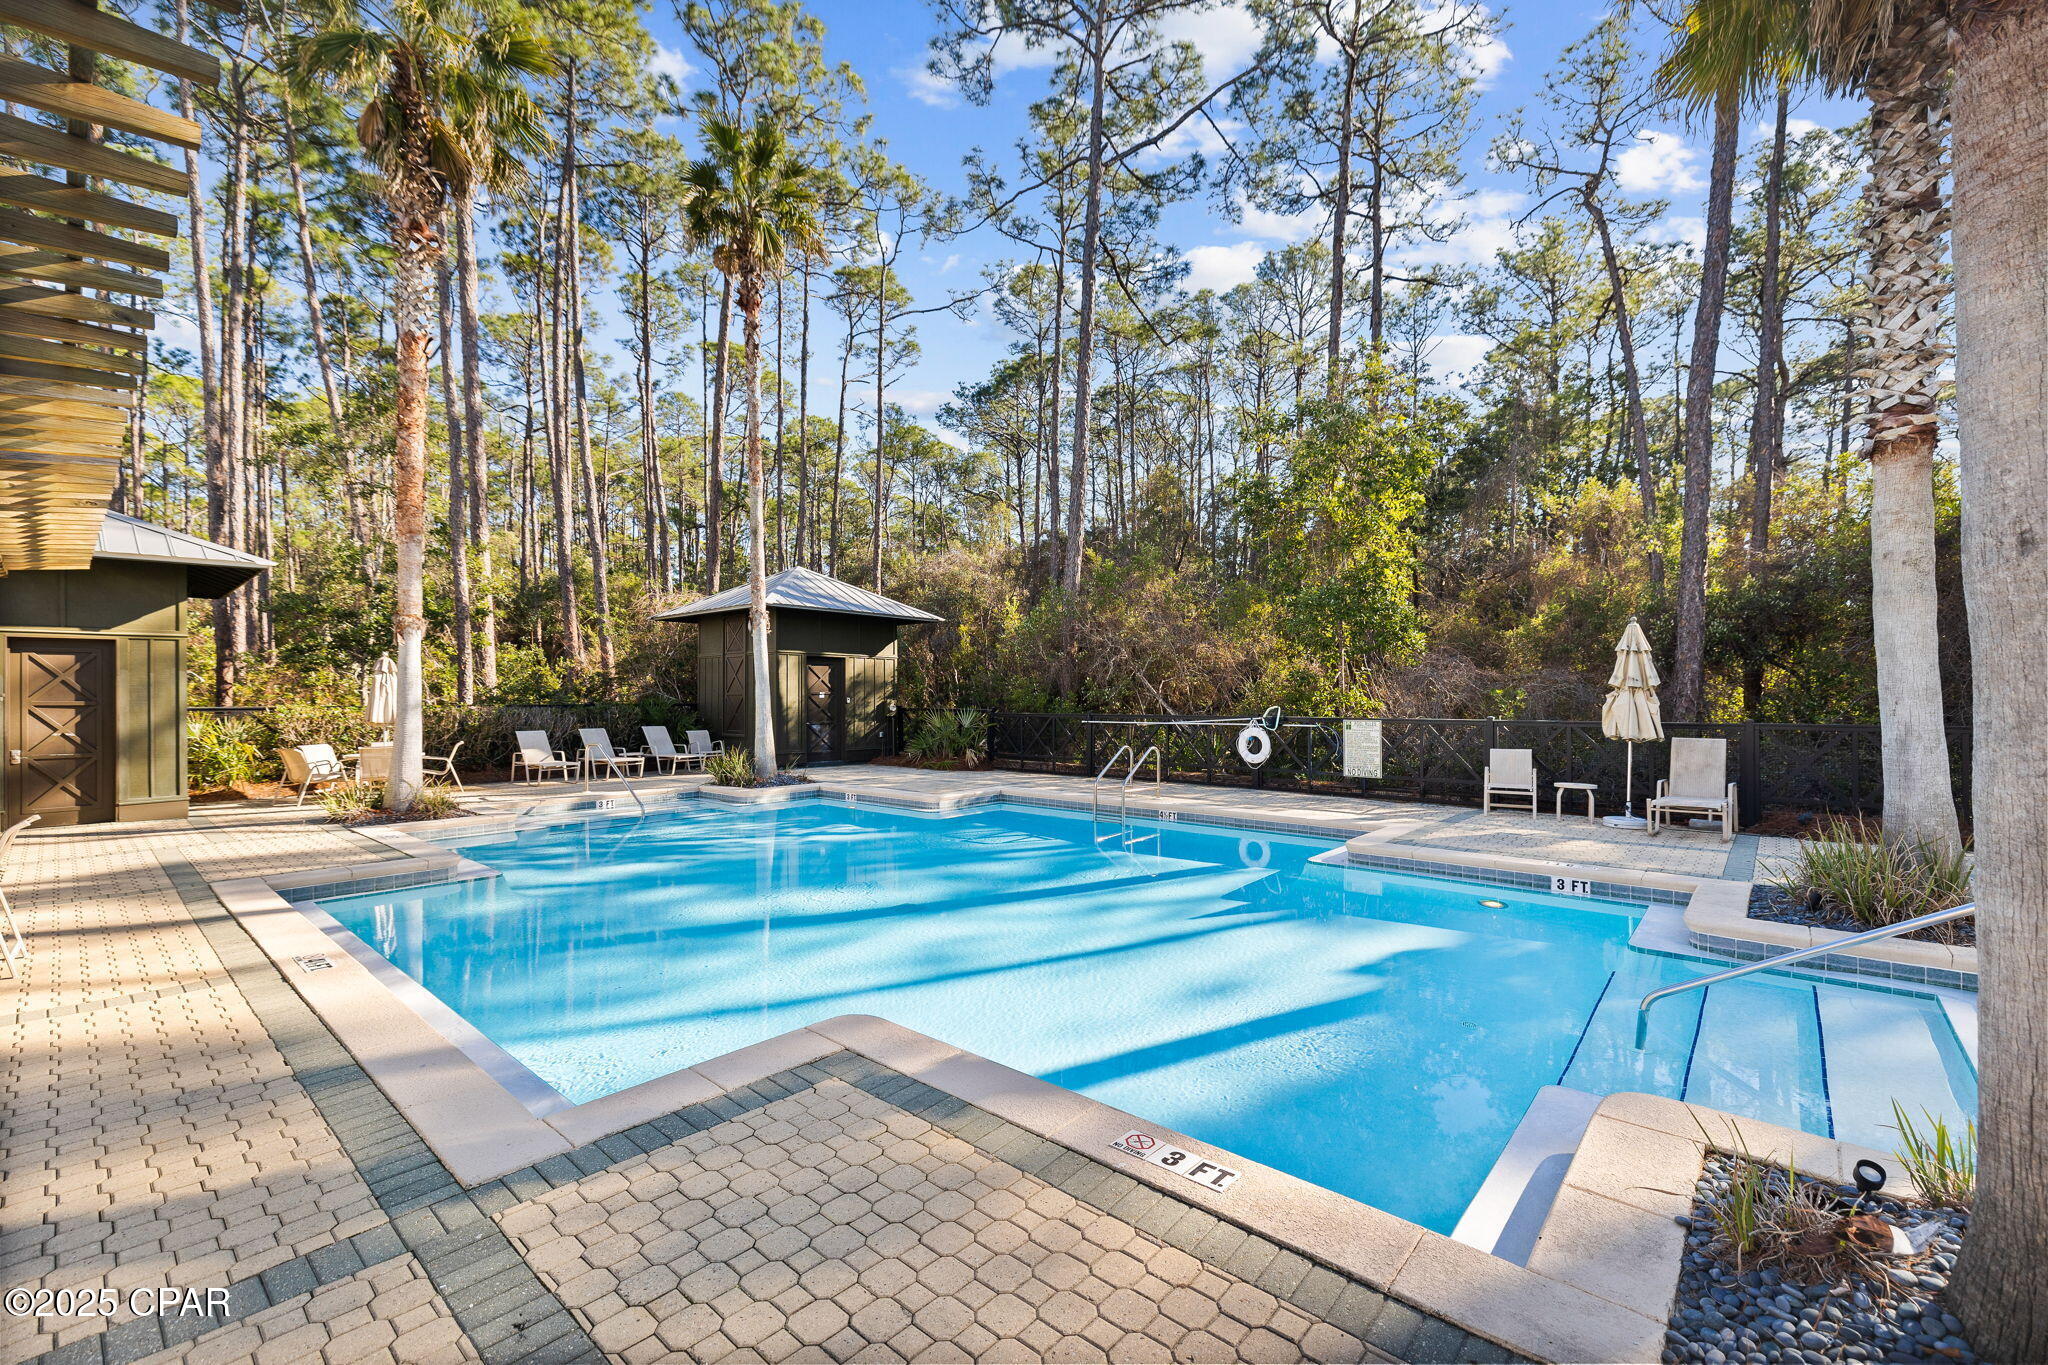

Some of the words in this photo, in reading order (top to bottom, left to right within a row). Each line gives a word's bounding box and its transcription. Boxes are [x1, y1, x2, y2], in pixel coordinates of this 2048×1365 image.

[1347, 768, 1356, 776] NO
[1357, 768, 1378, 777] DIVING
[598, 800, 604, 808] 3
[1557, 878, 1565, 890] 3
[1571, 879, 1589, 894] FT.
[1122, 1143, 1147, 1158] DIVING
[1161, 1151, 1187, 1167] 3
[1188, 1161, 1236, 1188] FT.
